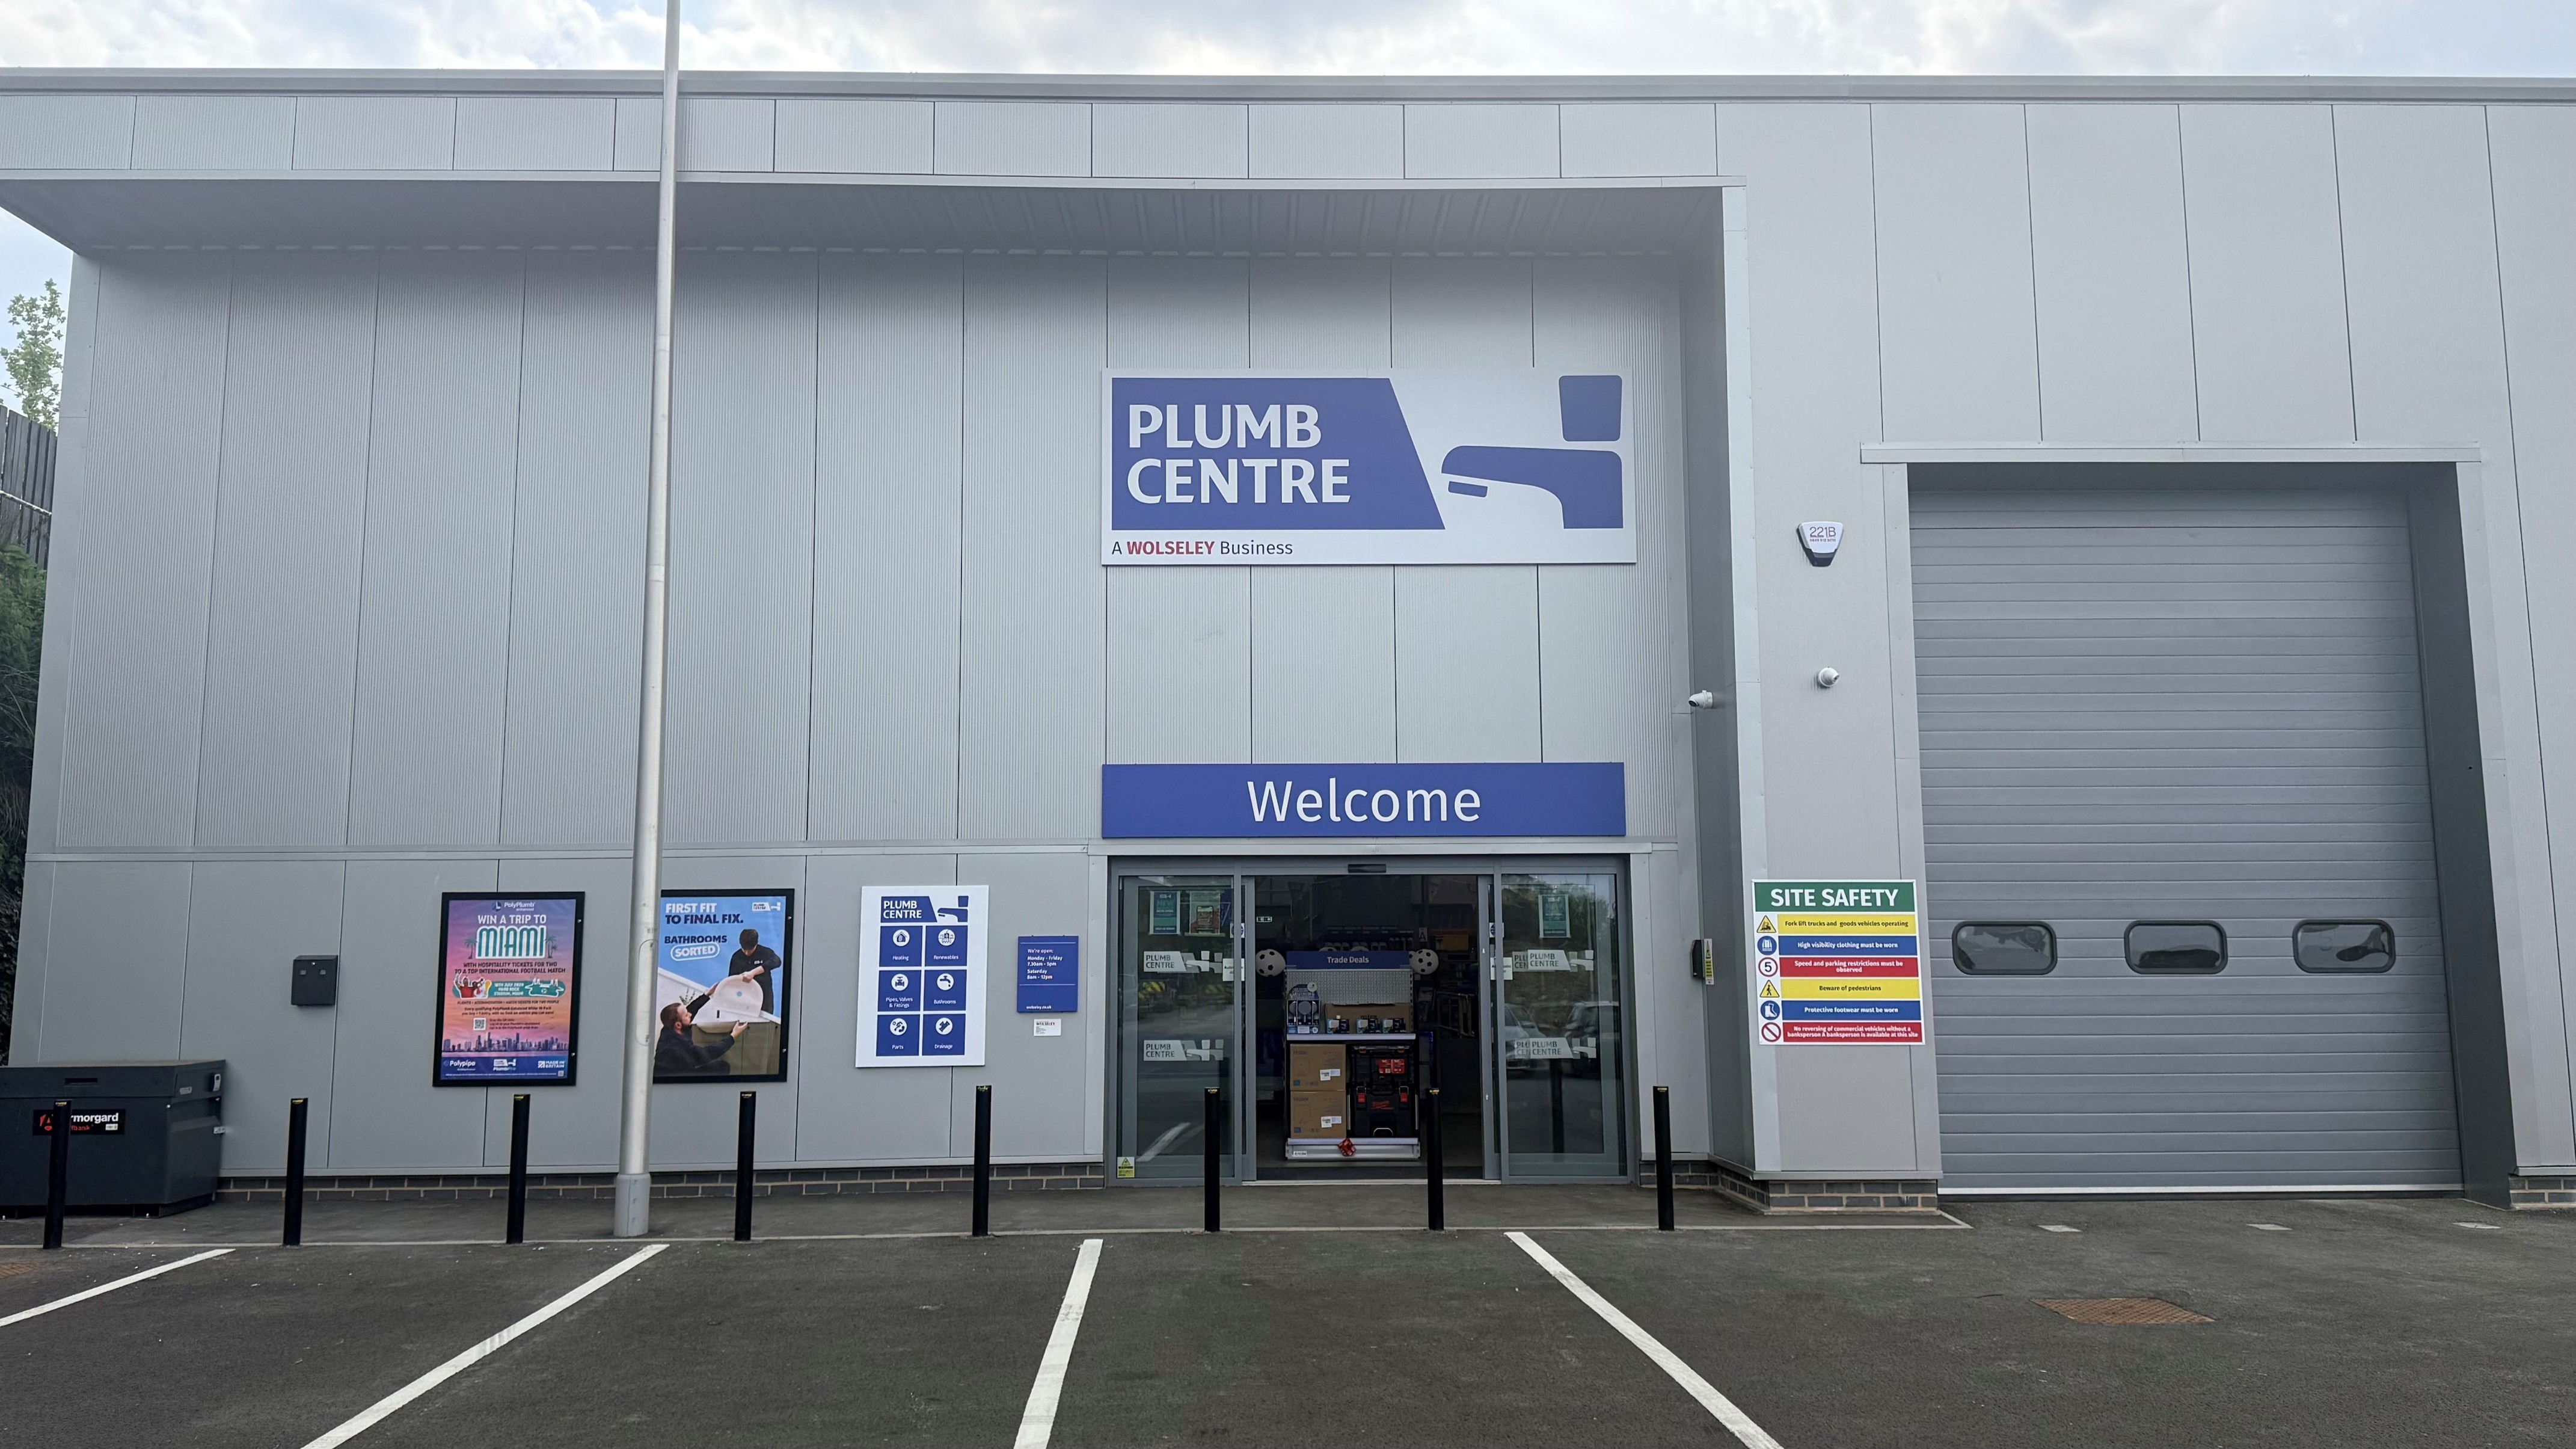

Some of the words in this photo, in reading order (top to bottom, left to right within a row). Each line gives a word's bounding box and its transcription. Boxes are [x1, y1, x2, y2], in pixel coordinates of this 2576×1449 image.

[1128, 404, 1322, 448] PLUMB
[1127, 458, 1351, 503] CENTRE
[1810, 527, 1836, 537] 221B
[1112, 541, 1122, 555] A
[1127, 541, 1215, 555] WOLSELEY
[1221, 540, 1293, 555] Business
[1247, 778, 1480, 822] Welcome
[1771, 889, 1815, 906] SITE
[1822, 889, 1898, 906] SAFETY
[666, 903, 698, 913] FIRST
[700, 903, 717, 913] FIT
[884, 900, 917, 909] PLUMB
[478, 915, 497, 924] WIN
[500, 915, 506, 924] A
[509, 915, 531, 924] TRIP
[533, 914, 547, 924] TO
[666, 915, 681, 924] TO
[684, 914, 719, 924] FINAL
[722, 914, 743, 924] FIX.
[883, 910, 922, 918] CENTRE
[477, 926, 545, 958] MIAMI
[664, 935, 727, 944] BATHROOMS
[675, 947, 716, 958] SORTED
[1765, 962, 1771, 972] 5
[71, 1113, 118, 1124] morgard
